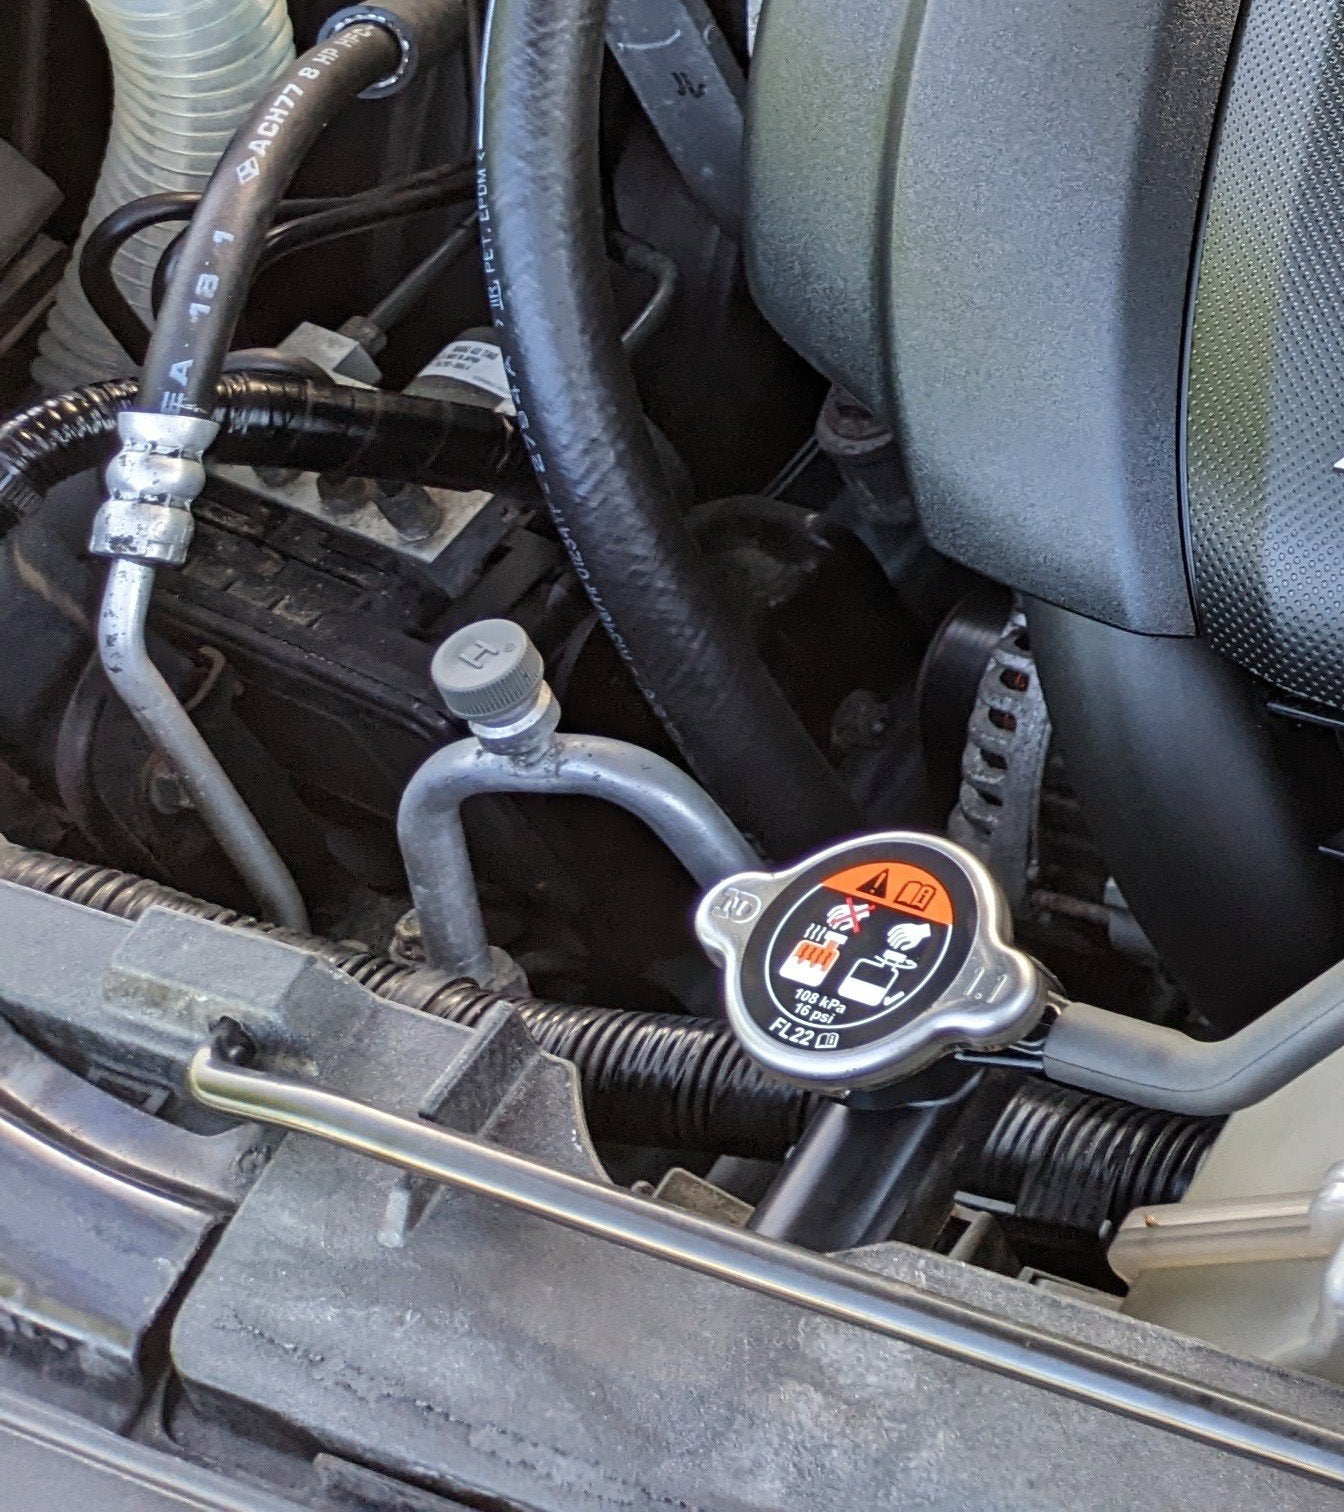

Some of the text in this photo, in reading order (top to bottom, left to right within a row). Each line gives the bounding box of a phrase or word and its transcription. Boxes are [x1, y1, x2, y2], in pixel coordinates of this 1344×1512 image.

[248, 83, 304, 156] ACH77
[794, 988, 847, 1014] 108 kPa
[794, 1002, 836, 1024] 16 psi
[768, 1016, 815, 1046] FL22
